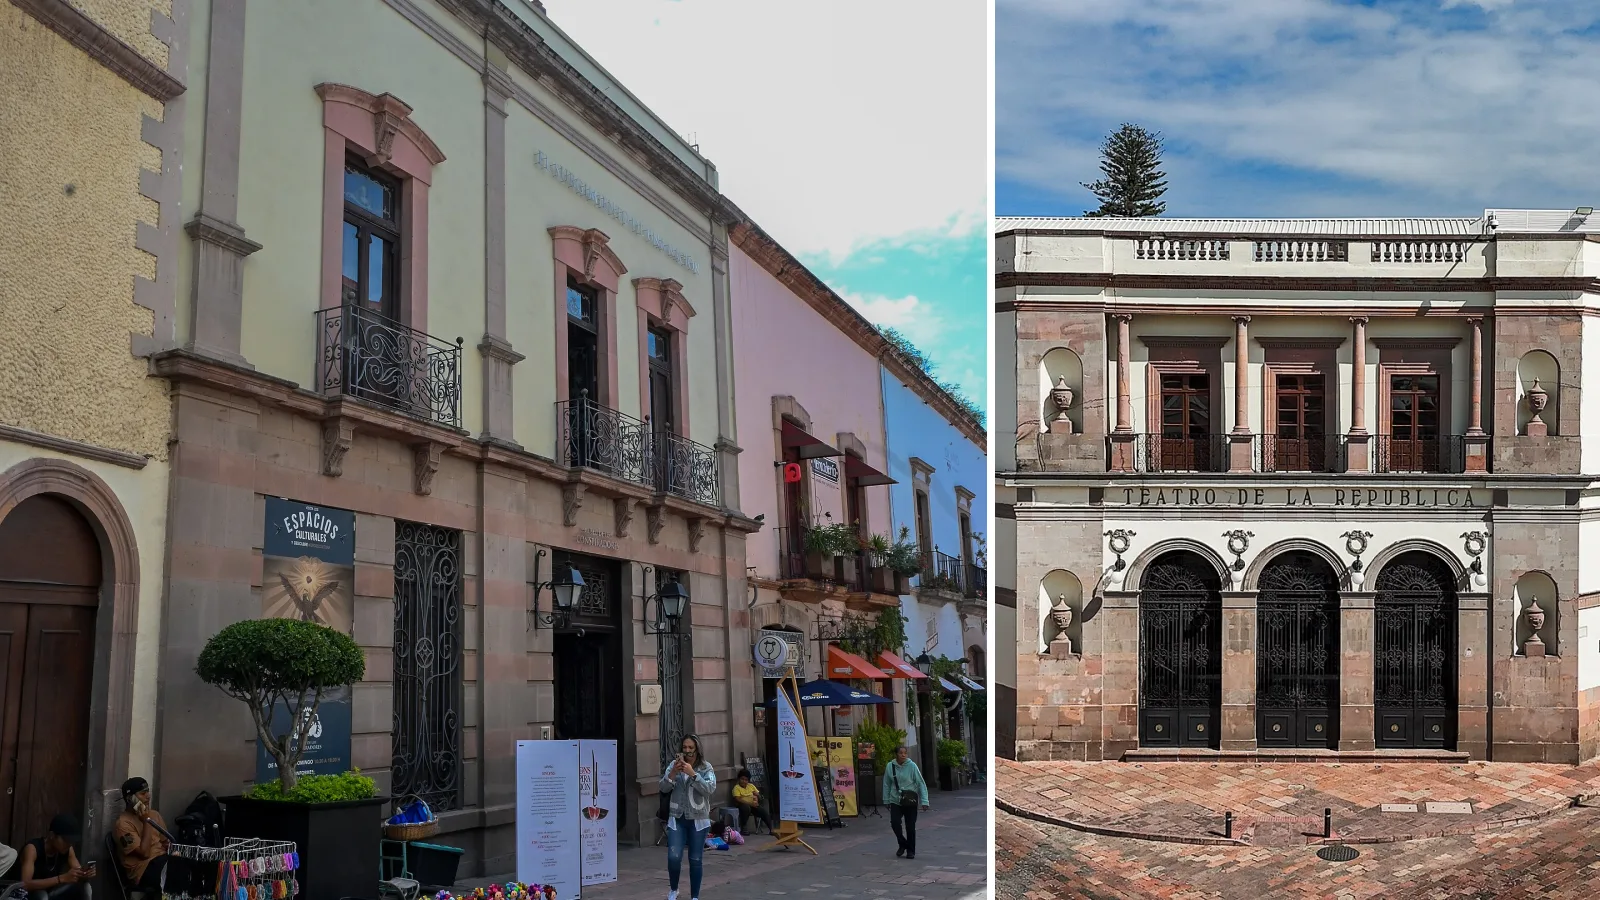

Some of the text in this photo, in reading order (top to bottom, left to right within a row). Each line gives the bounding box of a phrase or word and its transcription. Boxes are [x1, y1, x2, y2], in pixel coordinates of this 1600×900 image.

[1123, 488, 1475, 506] TEATRO DE LA REPUBLICA
[283, 511, 339, 540] ESPACIOS
[295, 529, 327, 543] CULTURALES
